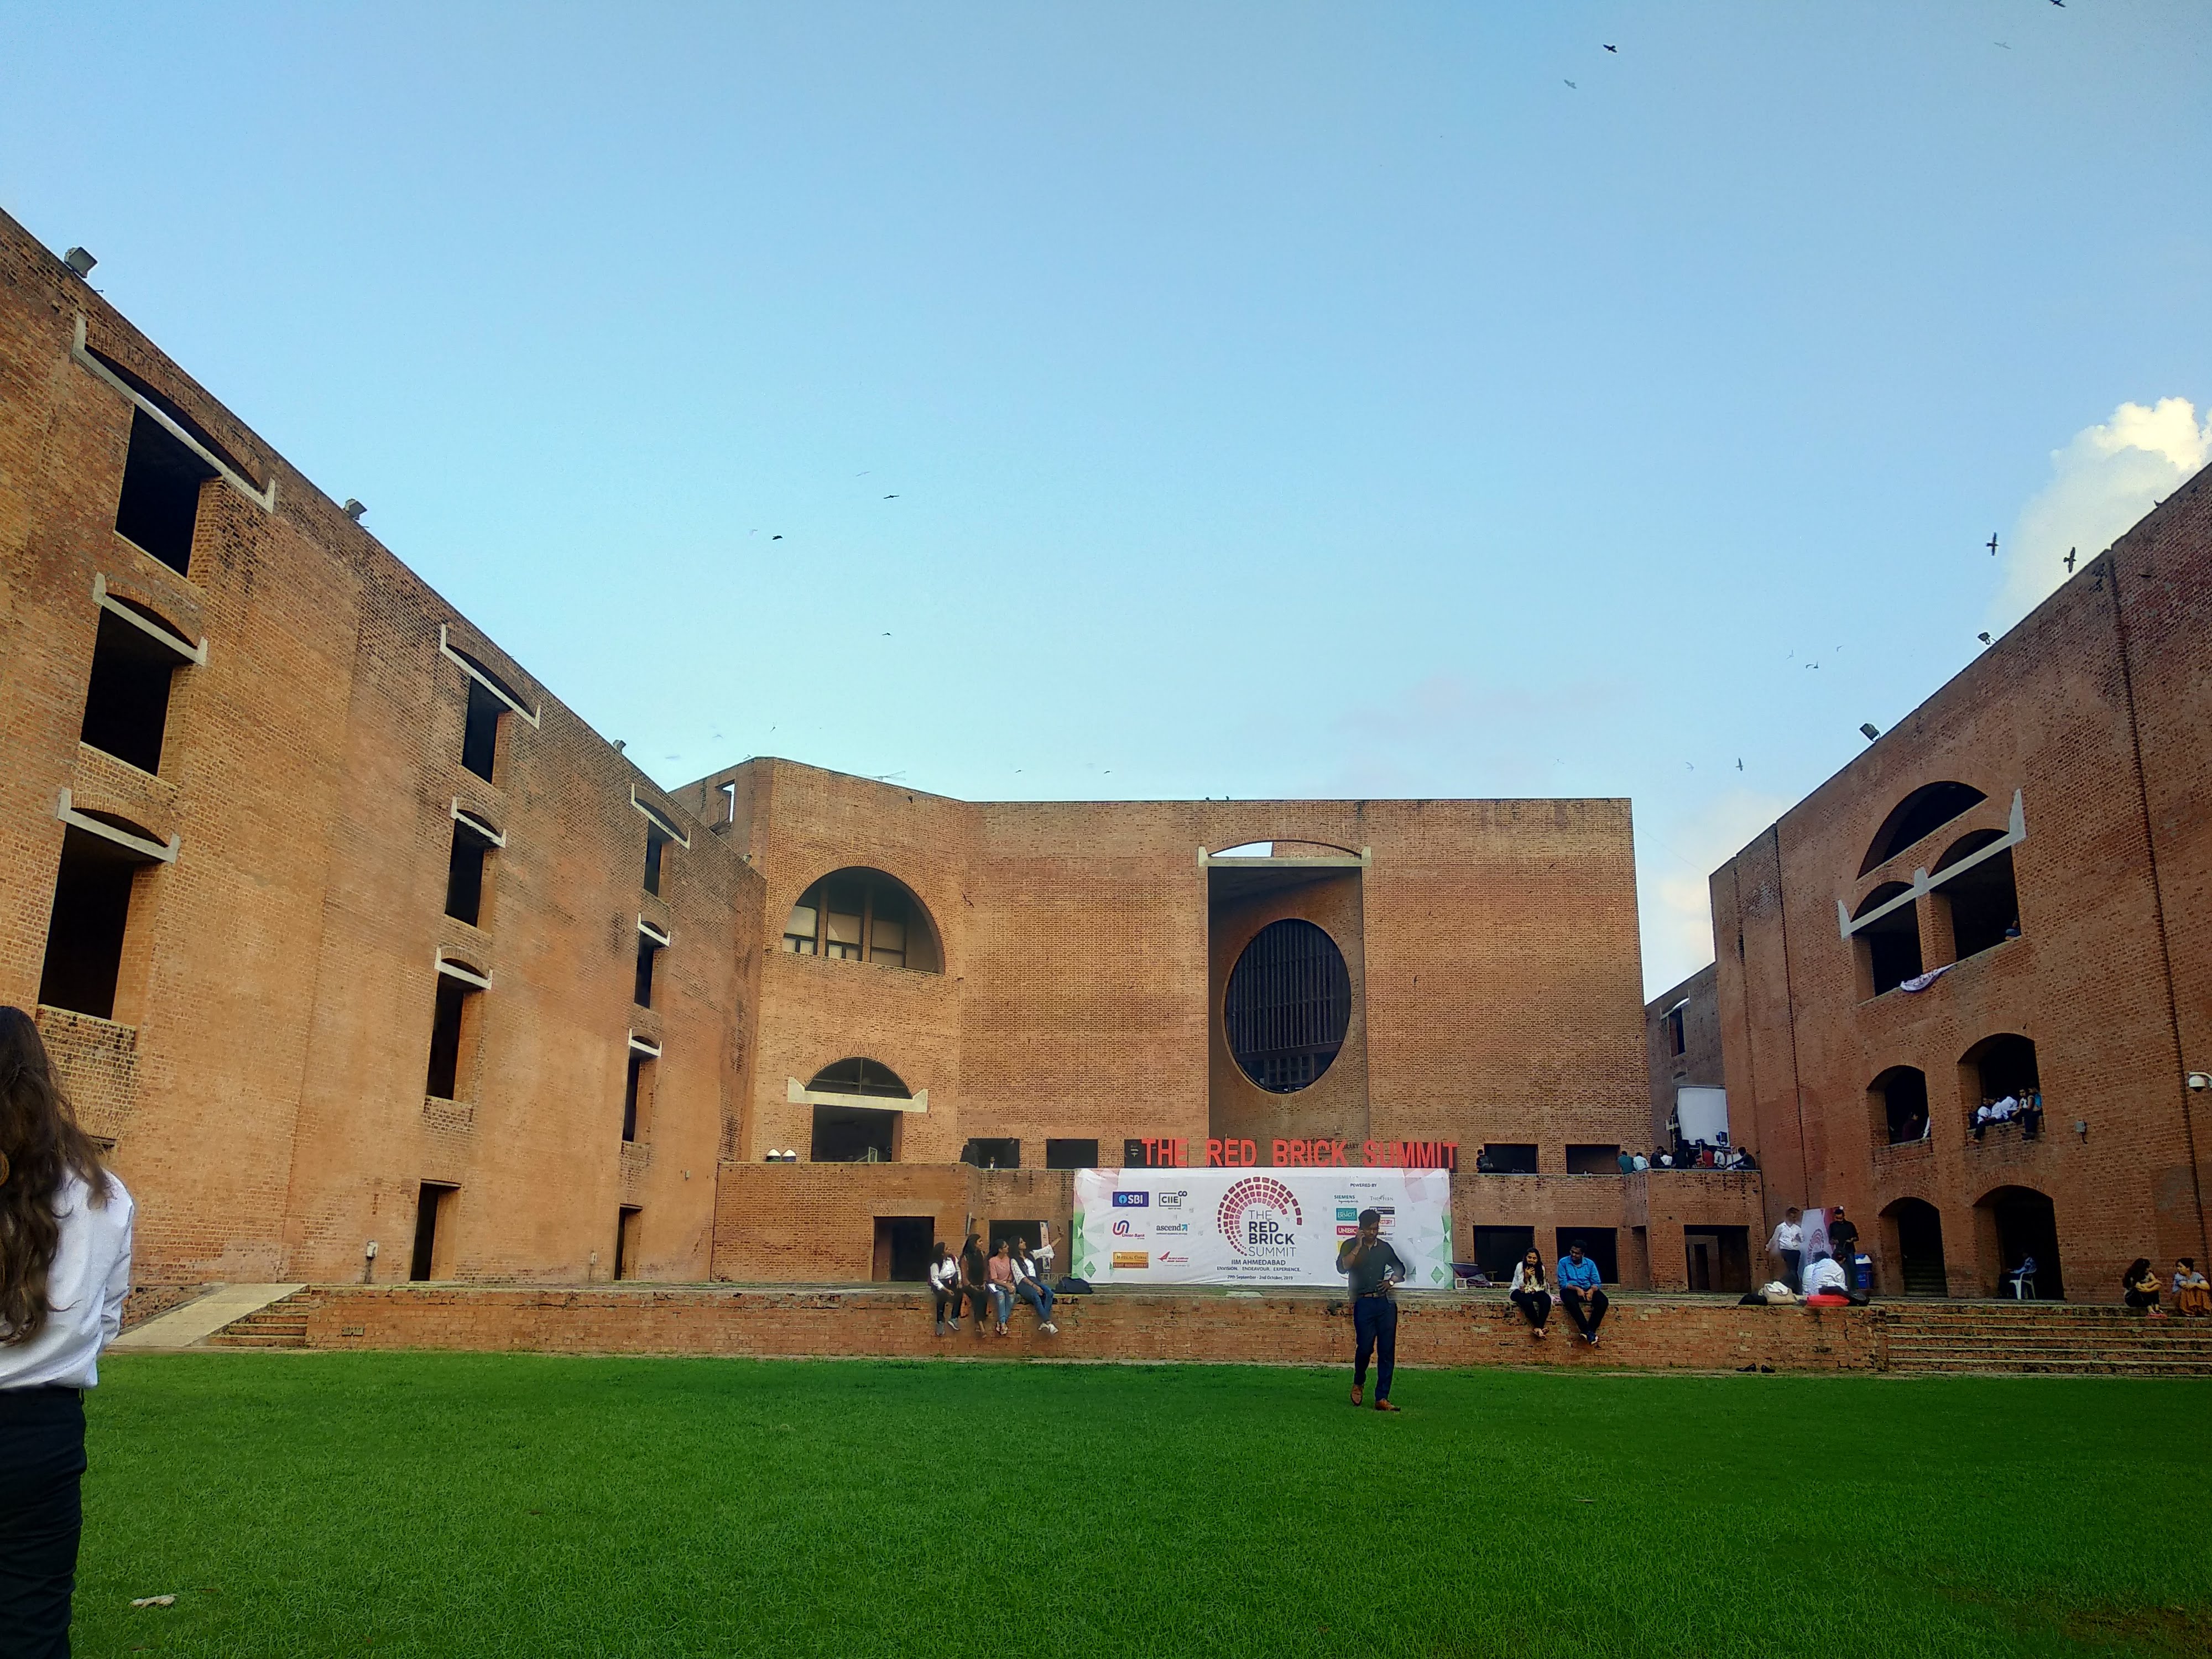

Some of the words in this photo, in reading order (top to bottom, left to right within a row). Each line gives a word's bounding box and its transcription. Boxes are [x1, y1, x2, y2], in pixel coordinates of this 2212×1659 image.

[1141, 1138, 1188, 1167] THE
[1206, 1138, 1257, 1167] RED
[1272, 1139, 1349, 1167] BRICK
[1363, 1139, 1458, 1168] SUMMIT
[1128, 1194, 1143, 1204] SBI
[1248, 1210, 1272, 1220] THE
[1249, 1222, 1279, 1233] RED
[1249, 1233, 1295, 1245] BRICK
[1249, 1246, 1297, 1257] SUMMIT
